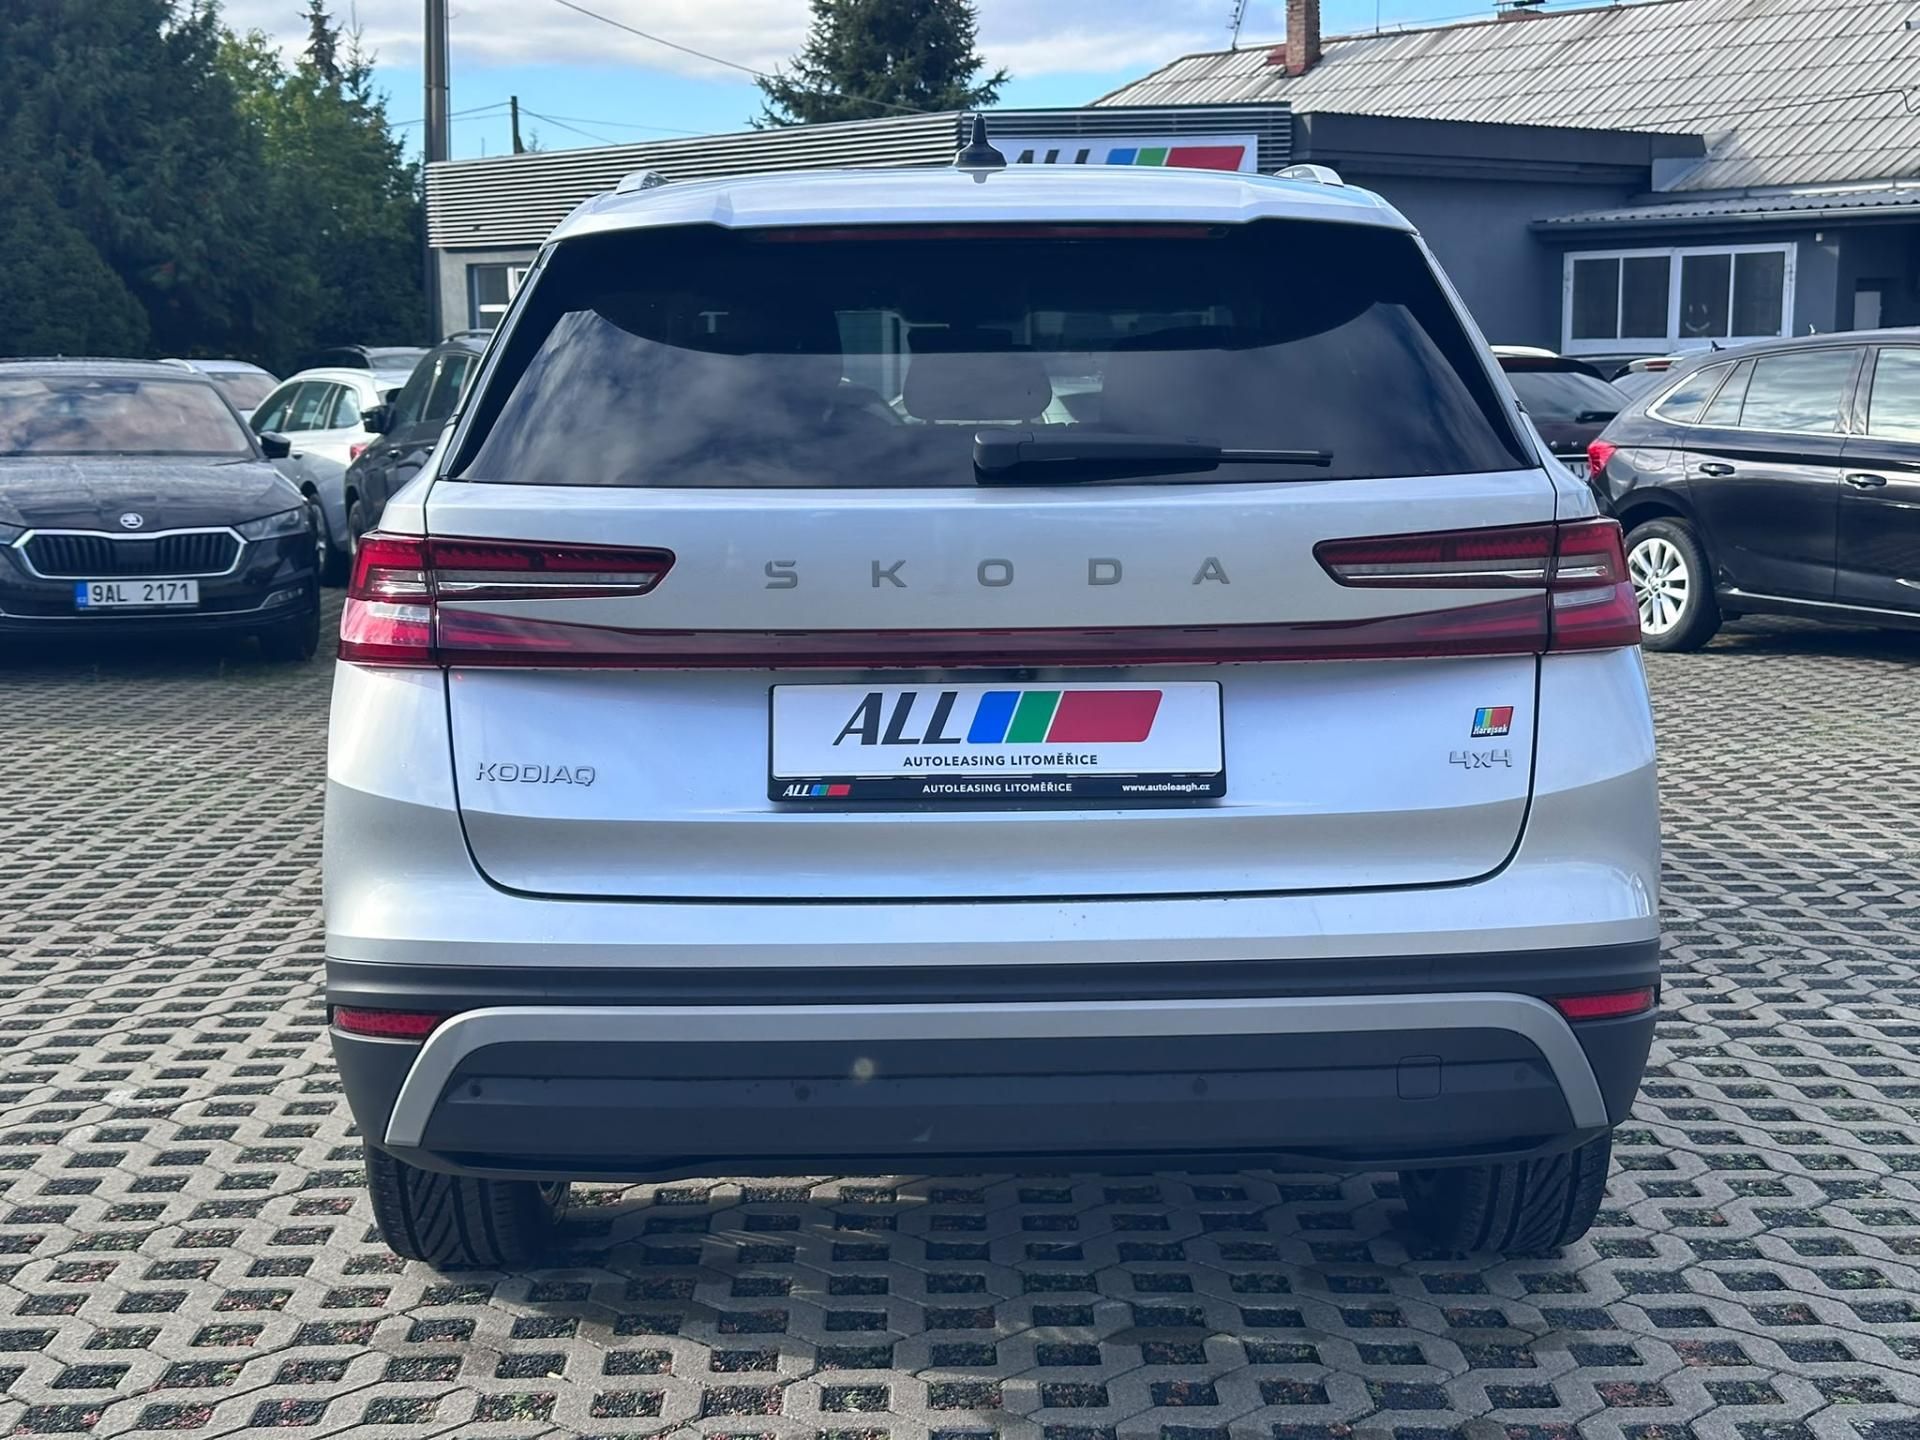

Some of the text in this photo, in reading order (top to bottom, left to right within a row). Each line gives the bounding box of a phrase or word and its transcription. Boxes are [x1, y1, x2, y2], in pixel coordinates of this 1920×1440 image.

[764, 556, 1231, 590] SKODA
[92, 583, 189, 603] 9AL 2171
[832, 690, 962, 746] ALL
[903, 751, 1099, 768] AUTOLEASING LITOMĚŘICE
[476, 761, 596, 787] KODIAQ
[782, 784, 811, 797] ALL
[921, 781, 1073, 794] AUTOLEASING LITOMĚŘICE
[1121, 782, 1211, 793] www.autoleasgh.cz
